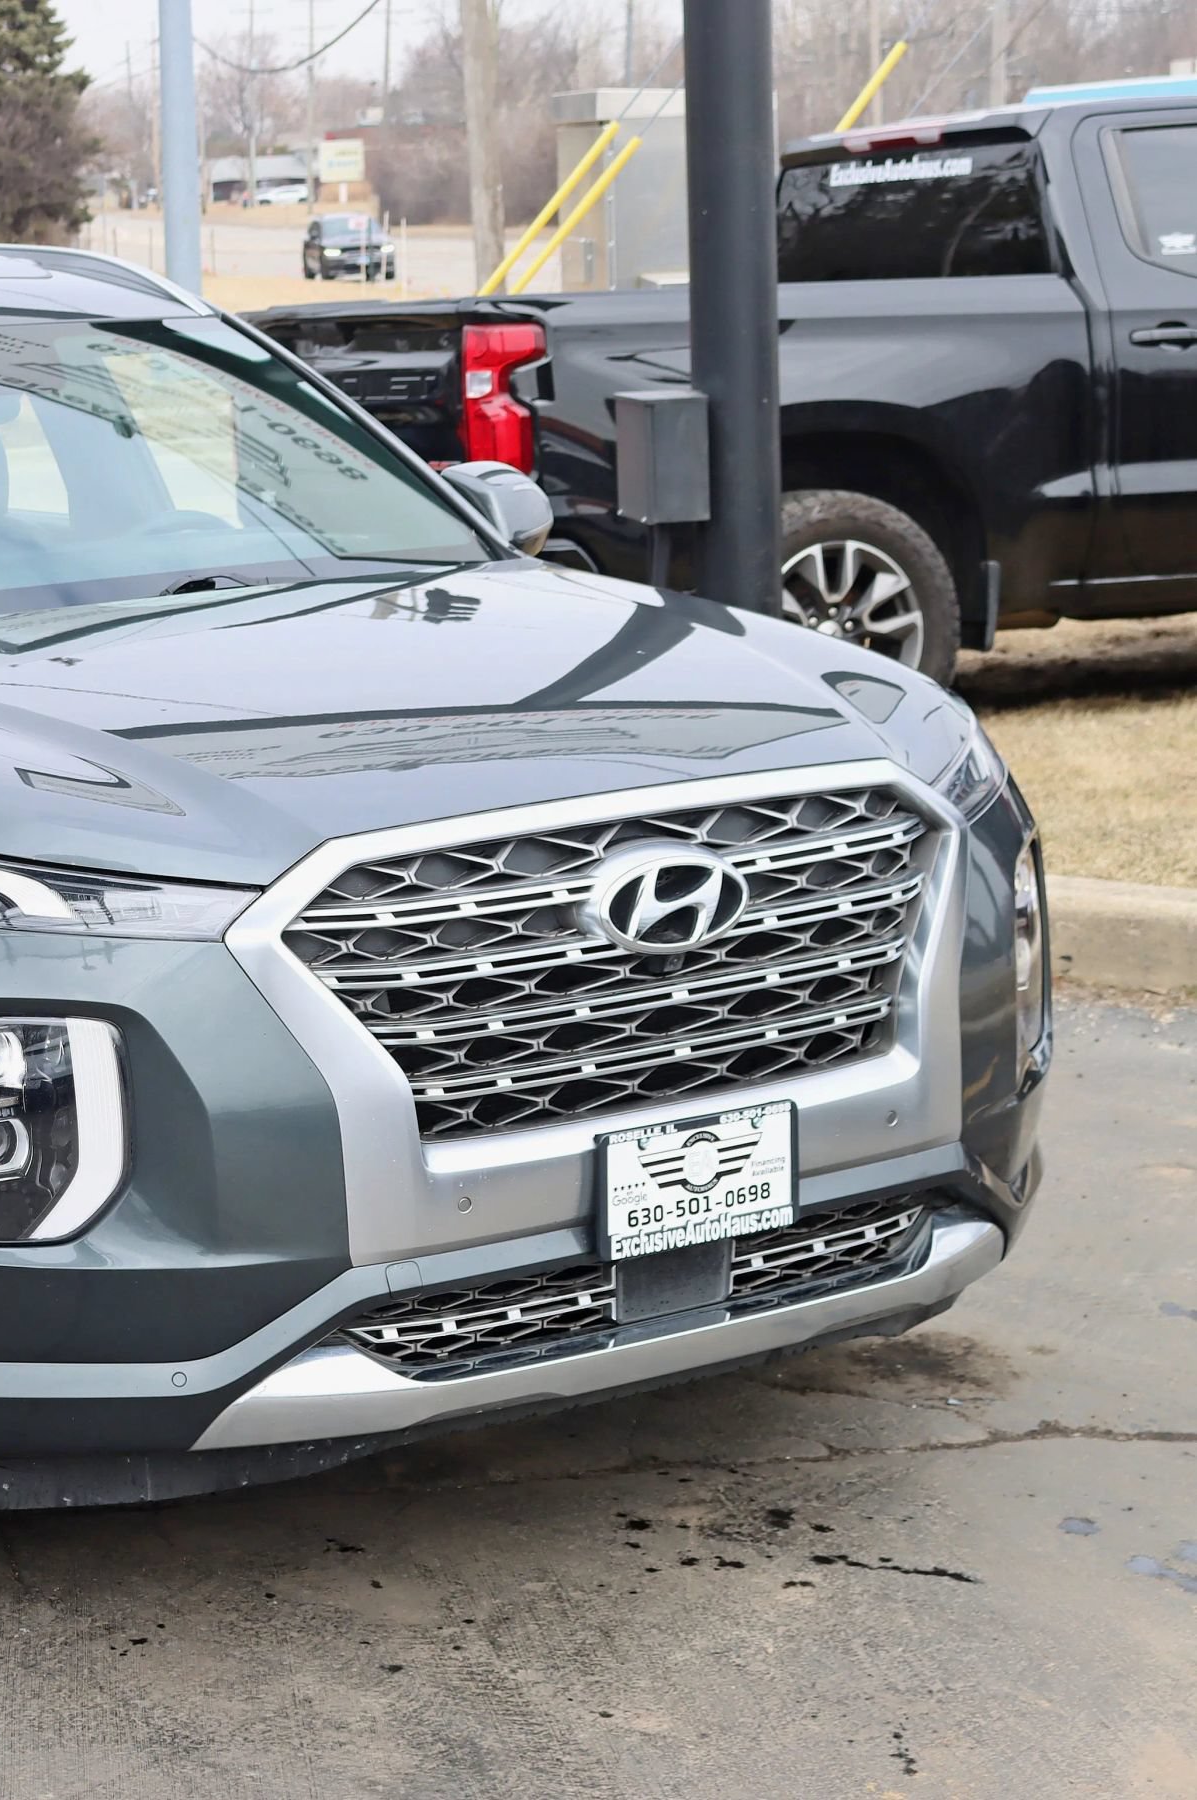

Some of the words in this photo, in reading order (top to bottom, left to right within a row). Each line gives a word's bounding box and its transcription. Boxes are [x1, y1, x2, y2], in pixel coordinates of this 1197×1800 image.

[666, 1123, 678, 1134] IL
[612, 1191, 648, 1207] Google
[627, 1181, 771, 1228] 630-501-0698
